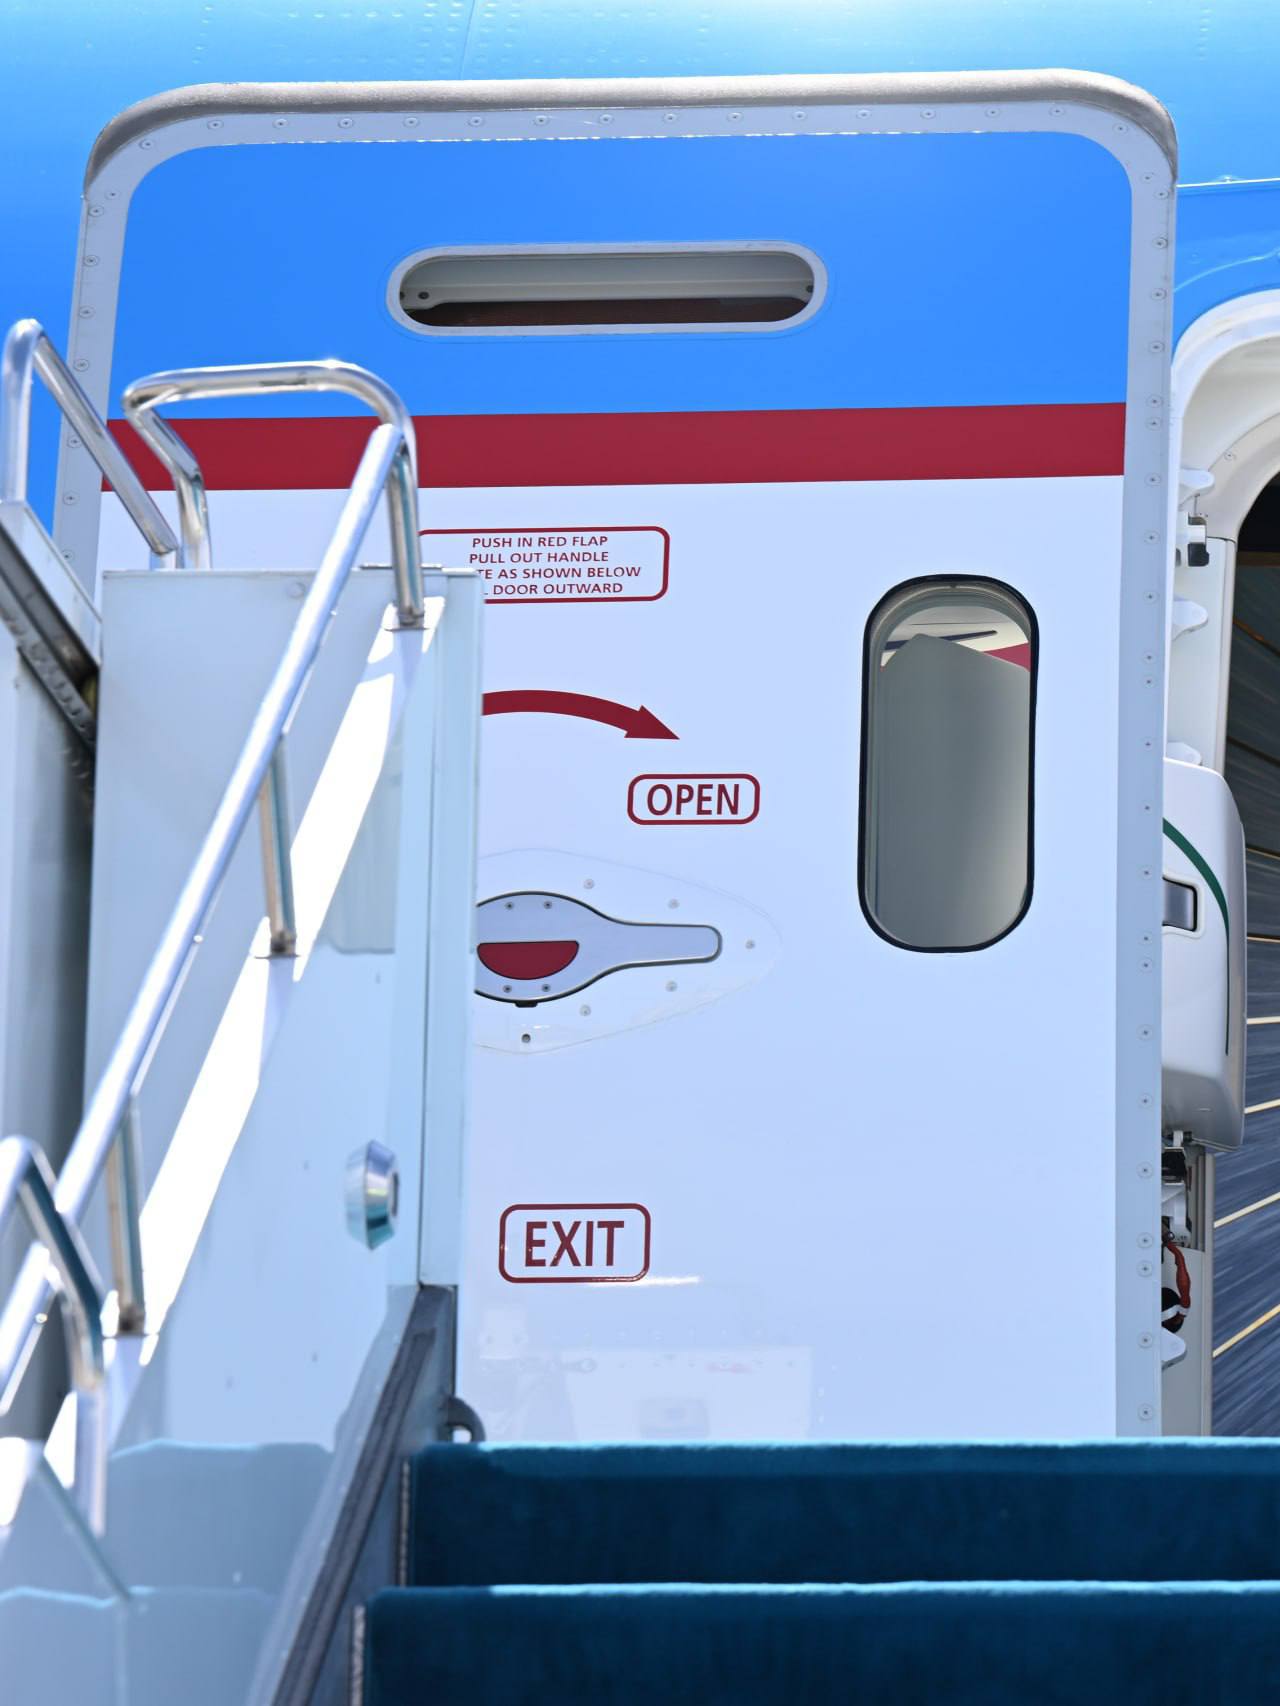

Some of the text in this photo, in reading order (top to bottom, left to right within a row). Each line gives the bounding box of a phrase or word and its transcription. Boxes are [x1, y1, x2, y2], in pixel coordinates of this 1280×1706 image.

[472, 535, 608, 548] PUSH IN RED FLAP
[469, 551, 609, 564] PULL OUT HANDLE
[498, 569, 518, 579] AS
[523, 568, 582, 578] SHOWN
[587, 566, 641, 577] BELOW
[493, 584, 538, 595] DOOR
[543, 583, 623, 594] OUTWARD
[646, 783, 740, 816] OPEN
[524, 1220, 625, 1268] EXIT
